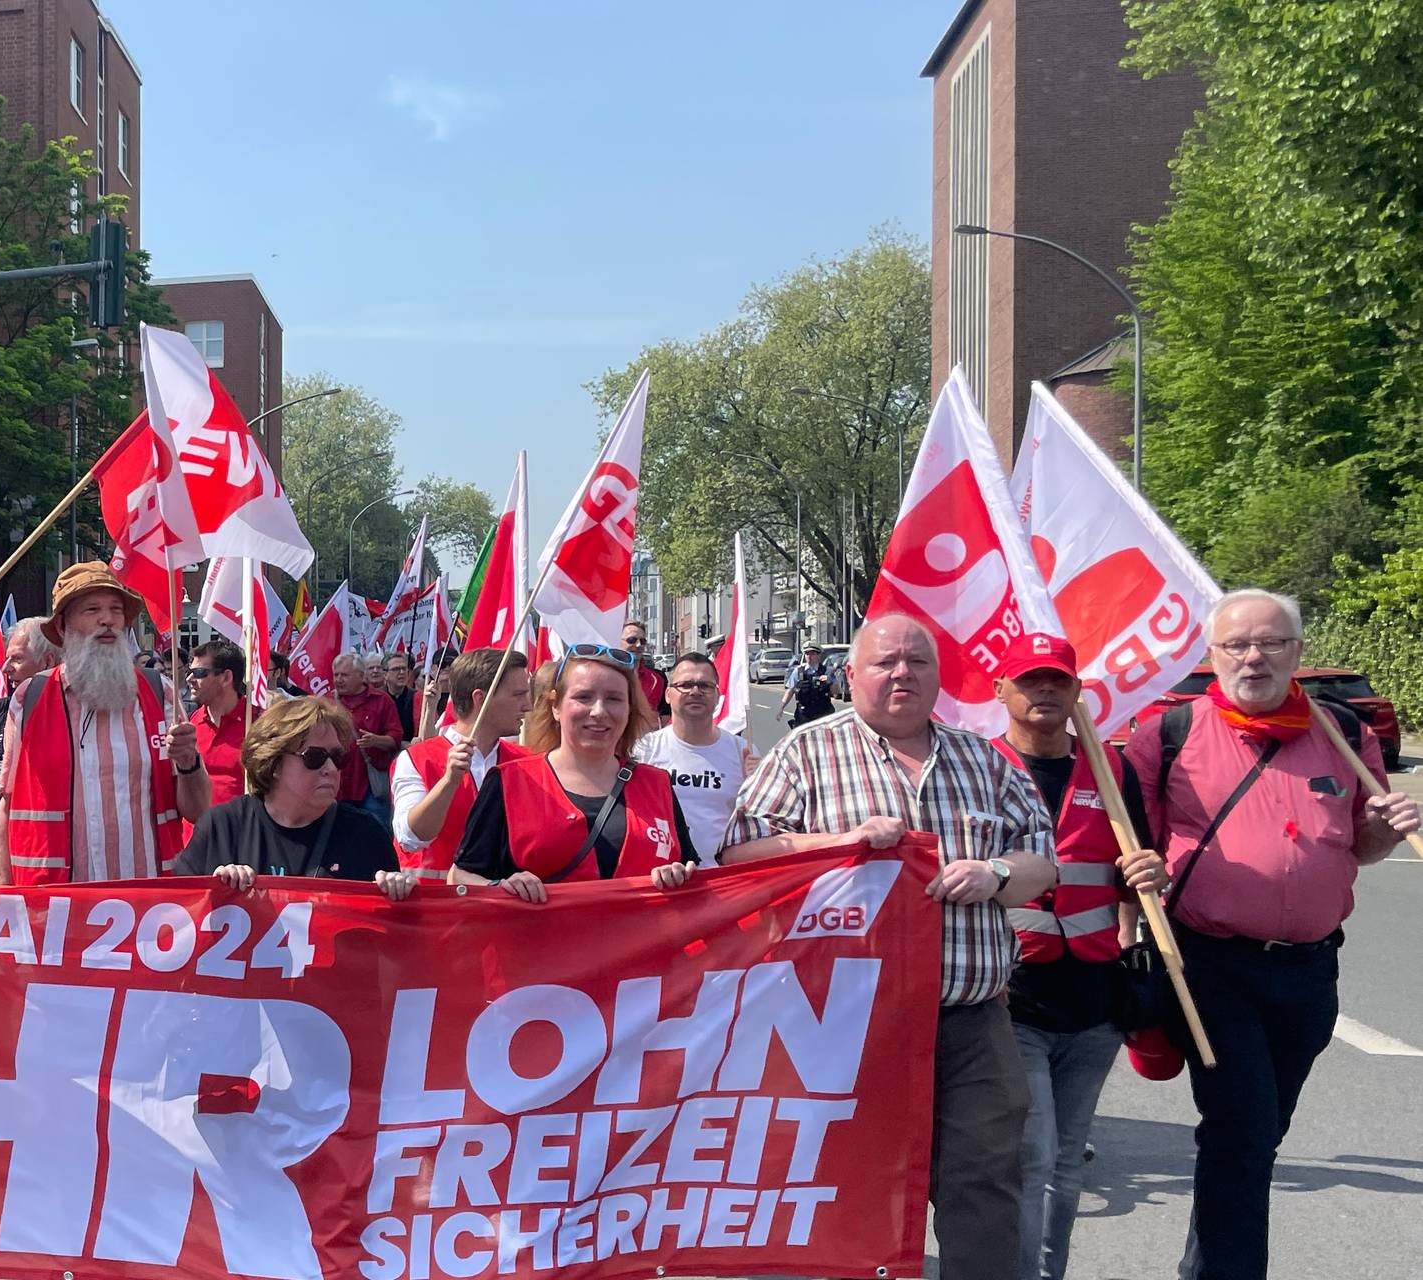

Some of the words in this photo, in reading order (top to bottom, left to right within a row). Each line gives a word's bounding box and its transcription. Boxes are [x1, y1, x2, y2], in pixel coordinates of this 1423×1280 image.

[150, 734, 167, 749] GE
[81, 899, 315, 979] 2024
[797, 906, 866, 933] DGB
[378, 957, 883, 1125] LOHN
[366, 1096, 858, 1214] FREIZEIT
[358, 1186, 839, 1280] SICHERHEIT
